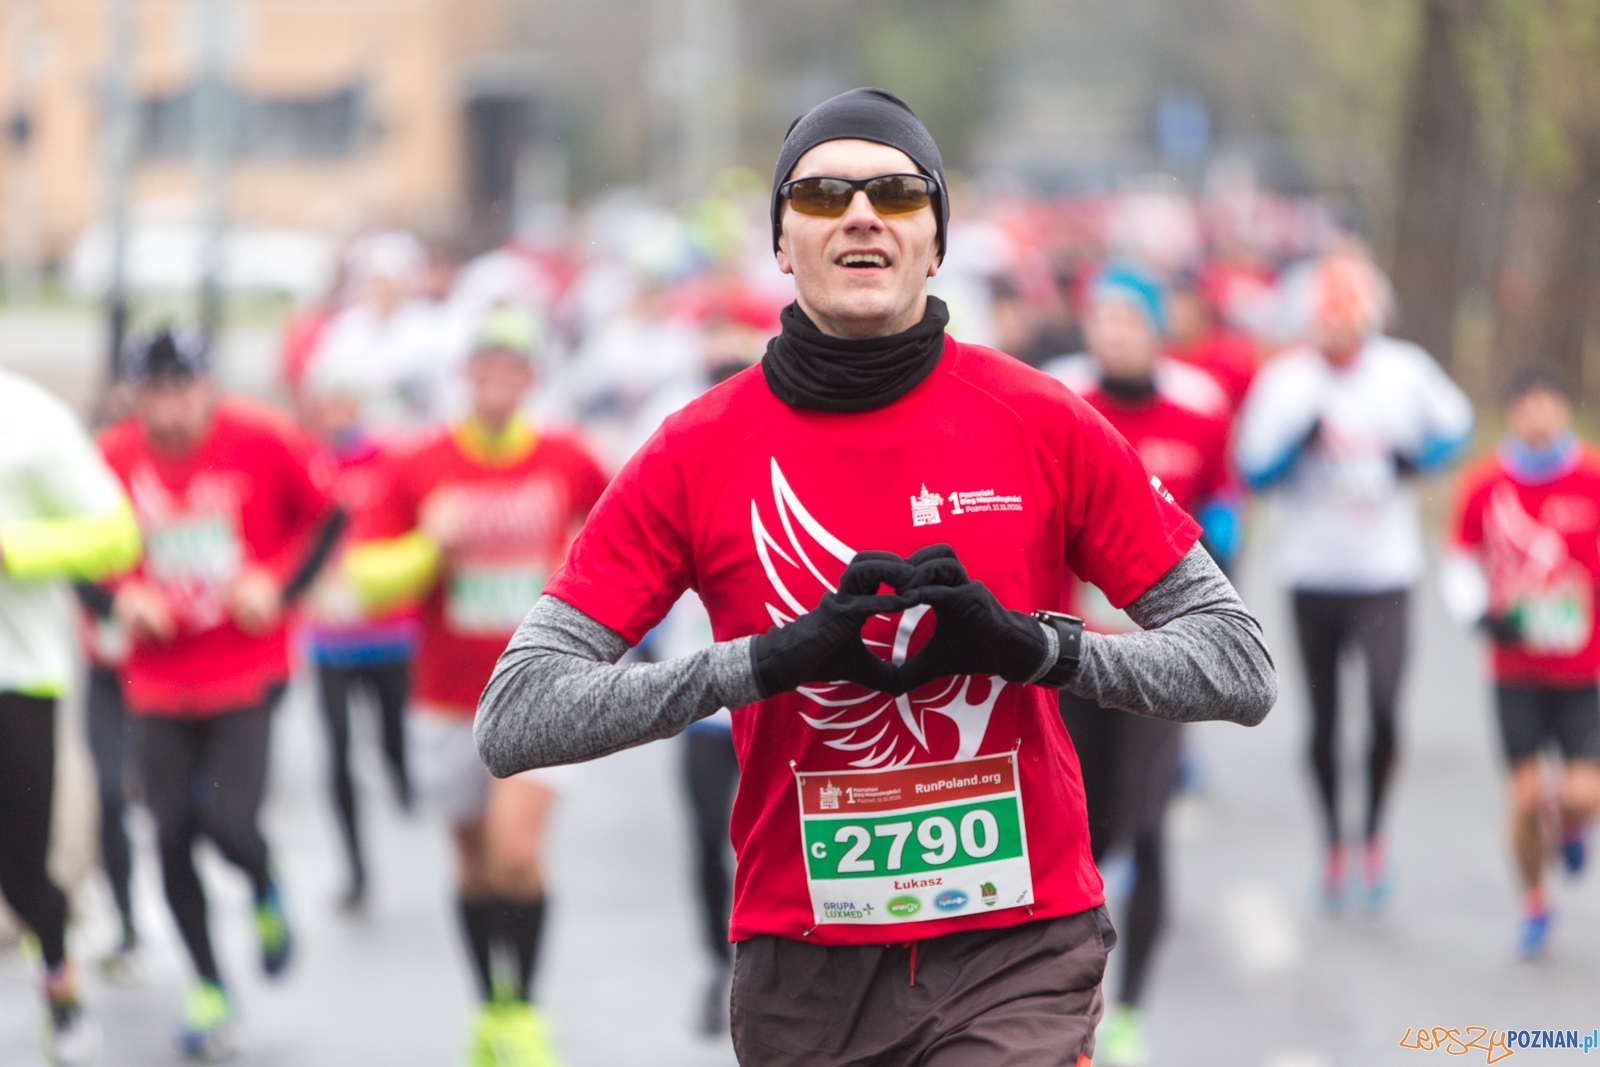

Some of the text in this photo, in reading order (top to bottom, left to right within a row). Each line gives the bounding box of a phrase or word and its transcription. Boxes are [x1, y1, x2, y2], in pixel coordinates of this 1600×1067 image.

[958, 489, 995, 498] Poznański
[948, 491, 964, 515] 1
[915, 773, 1001, 794] RunPoland.org
[845, 786, 856, 804] 1
[833, 808, 1000, 874] 2790
[893, 877, 944, 891] Łukasz
[823, 901, 856, 911] GRUPA
[825, 910, 863, 919] LUXMED
